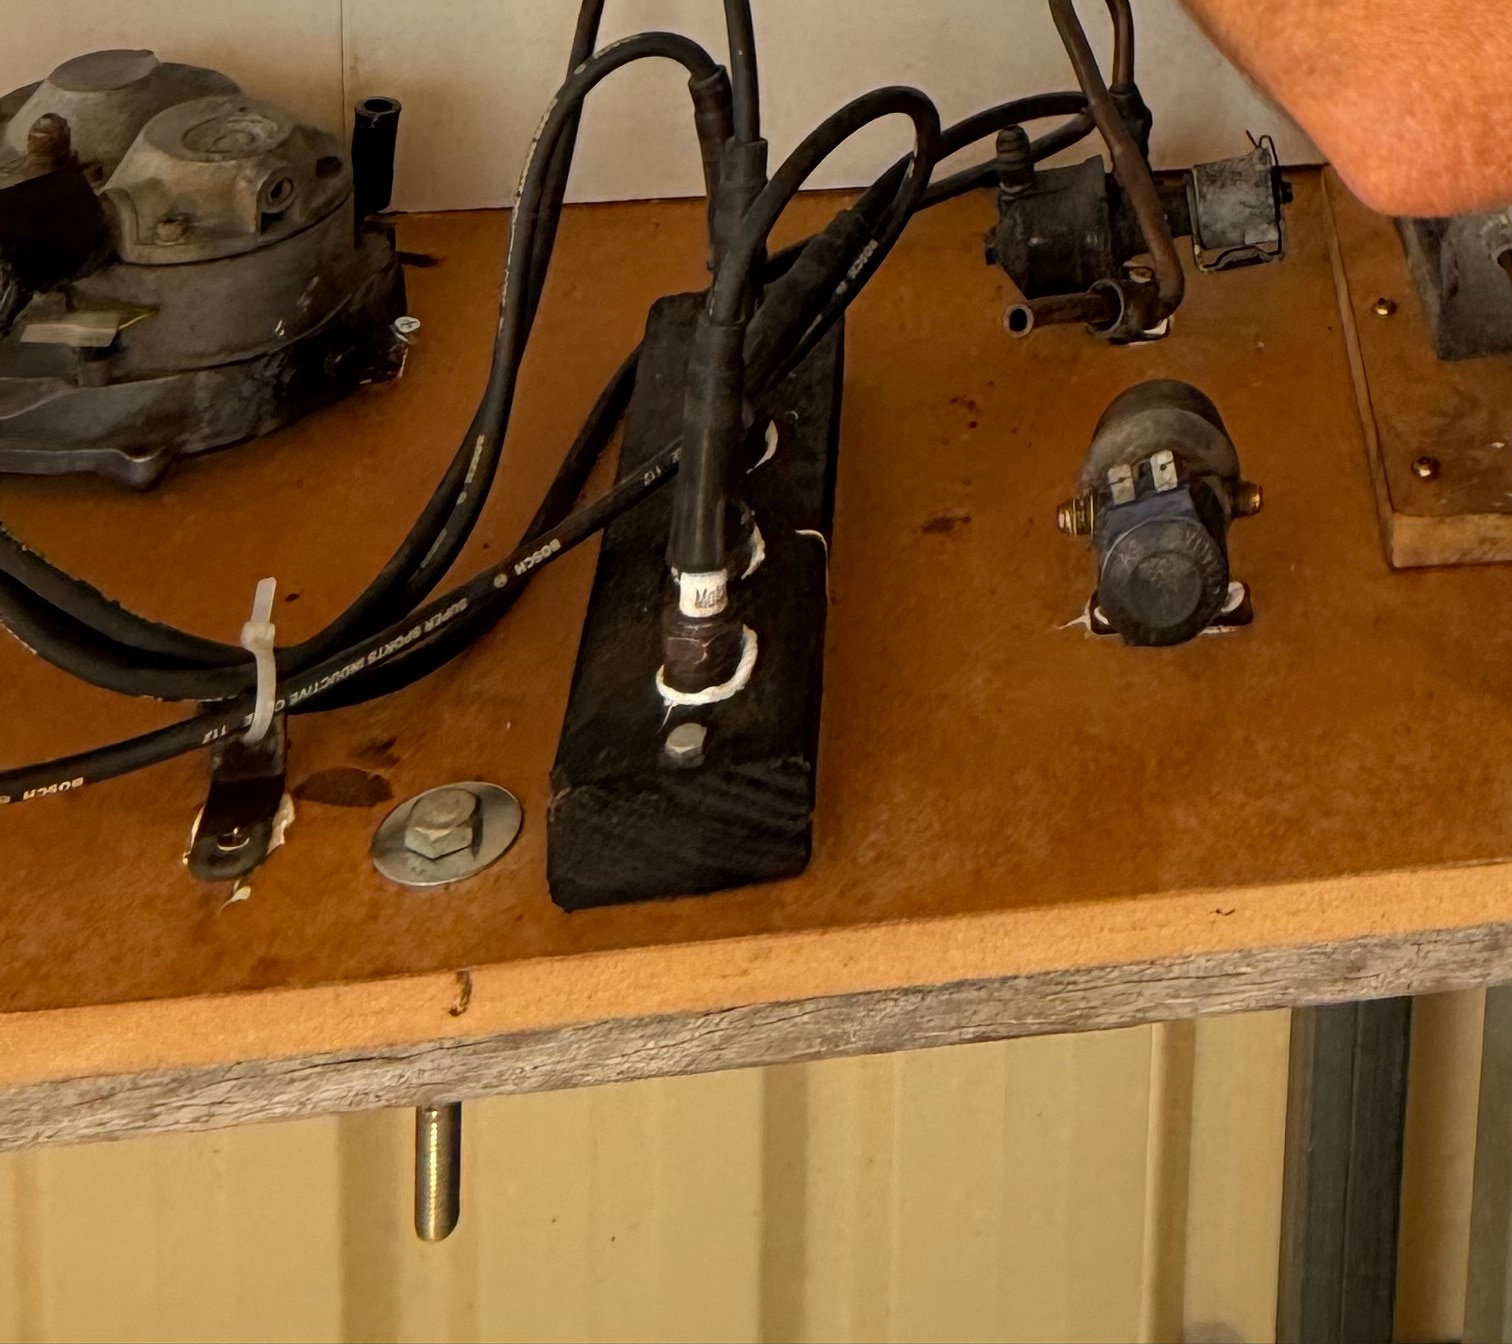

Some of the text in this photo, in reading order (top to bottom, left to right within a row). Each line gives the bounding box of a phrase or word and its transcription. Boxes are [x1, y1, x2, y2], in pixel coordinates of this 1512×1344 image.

[514, 538, 561, 575] BOSCH
[289, 597, 469, 707] SUPER SPORTS INDUCTIVE
[22, 777, 84, 801] BOSCH
